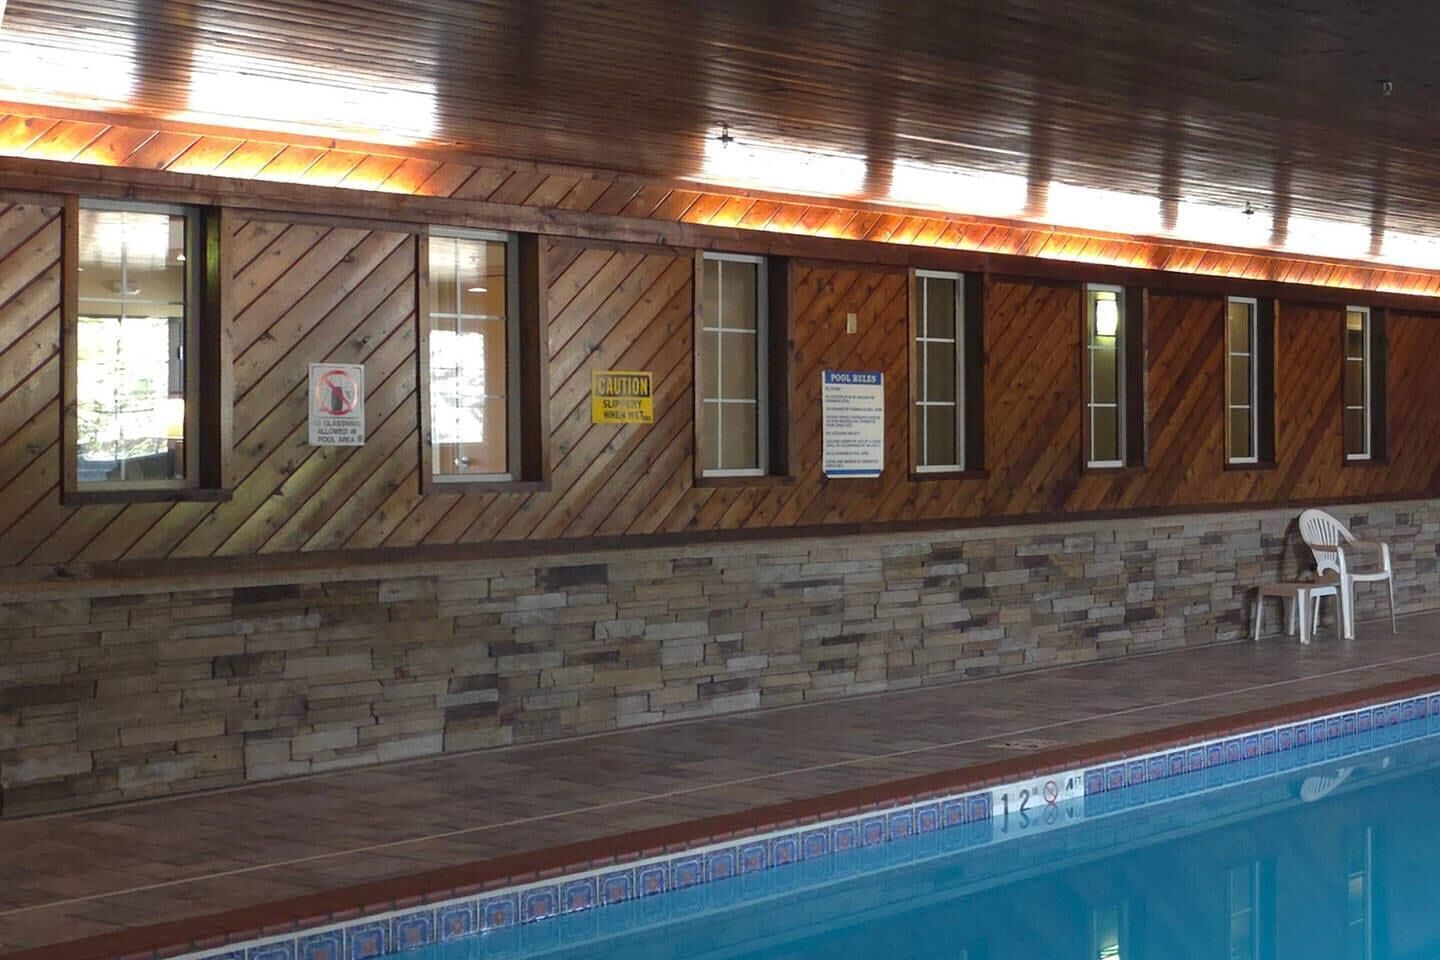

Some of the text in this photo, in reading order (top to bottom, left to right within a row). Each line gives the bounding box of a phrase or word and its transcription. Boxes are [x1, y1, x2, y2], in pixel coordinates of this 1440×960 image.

[830, 373, 876, 383] POOL RULES
[598, 377, 648, 395] CAUTION
[602, 399, 641, 408] SLIPPERY
[603, 410, 625, 418] WHEN
[627, 410, 645, 418] WET
[318, 435, 335, 443] POOL
